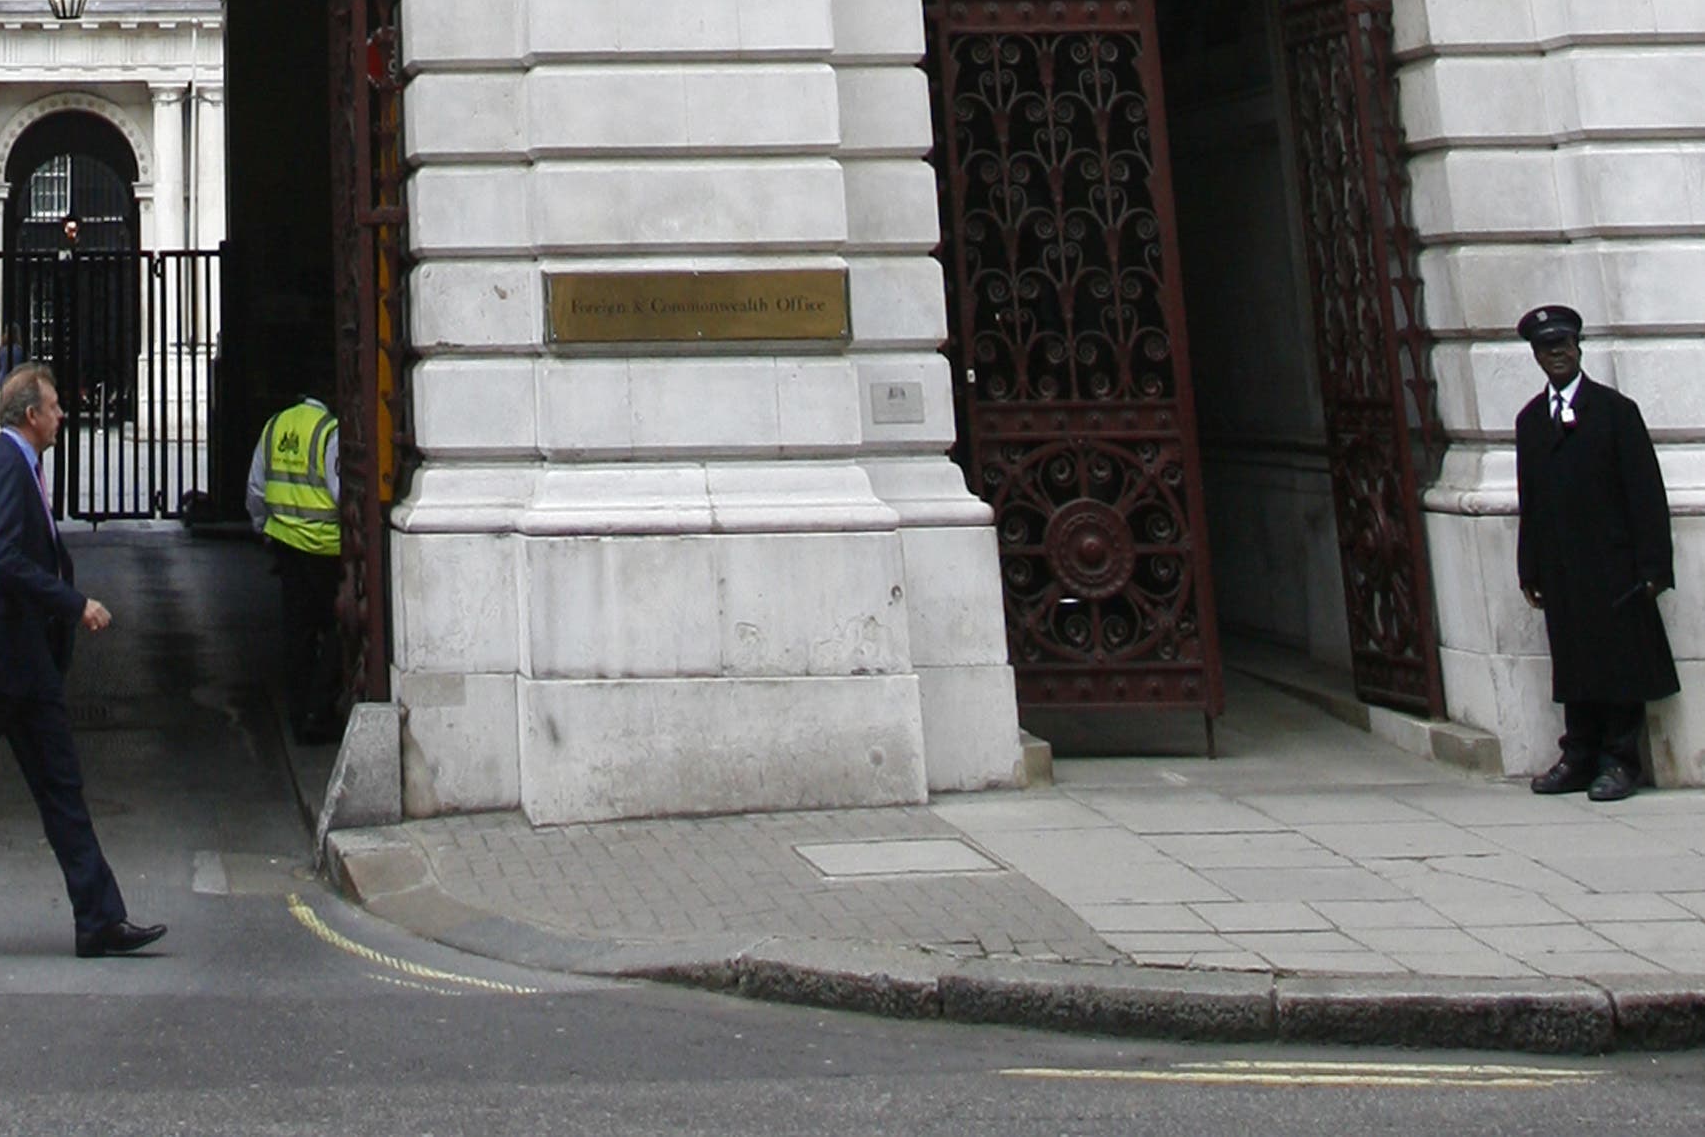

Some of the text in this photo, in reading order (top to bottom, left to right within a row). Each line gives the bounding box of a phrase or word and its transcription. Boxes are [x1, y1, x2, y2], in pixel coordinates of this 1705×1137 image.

[571, 296, 825, 316] Foreign & Commonwealth Office
